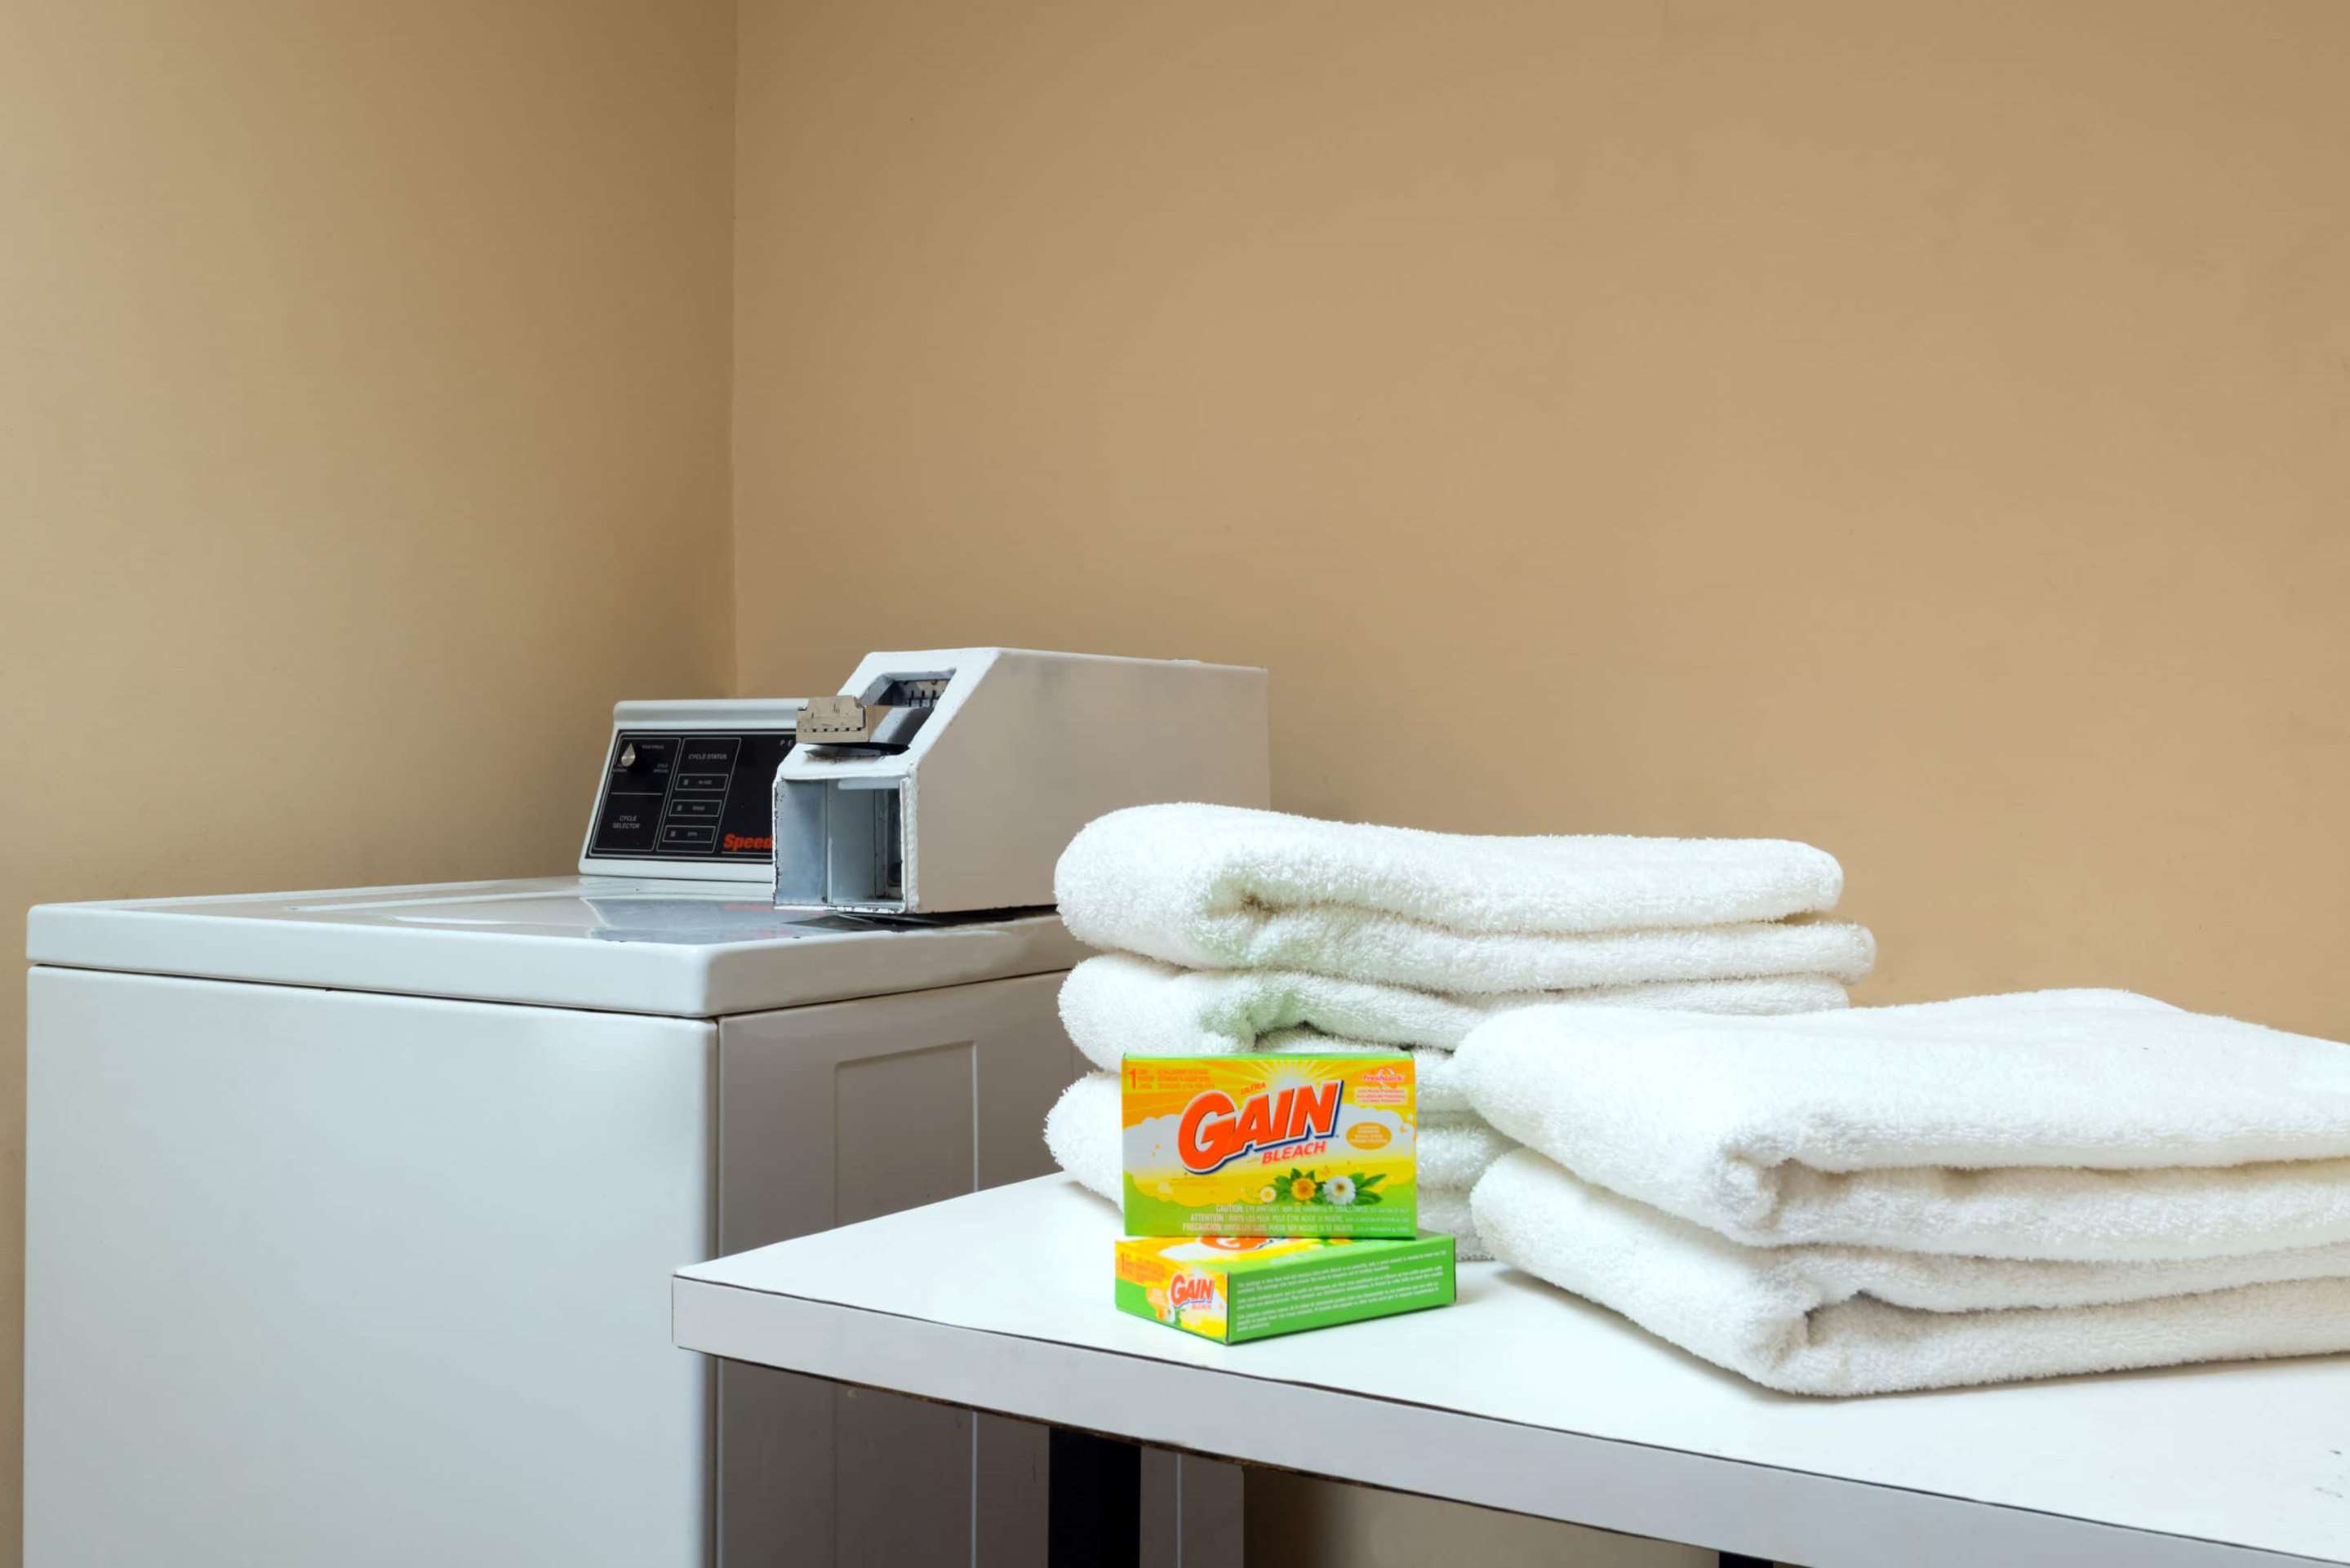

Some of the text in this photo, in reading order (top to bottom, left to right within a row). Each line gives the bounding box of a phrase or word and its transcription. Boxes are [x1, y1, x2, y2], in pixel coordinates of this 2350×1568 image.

[723, 833, 774, 851] Speed
[1240, 1082, 1267, 1095] ULTRA
[1177, 1081, 1343, 1173] GAIN
[1261, 1140, 1326, 1165] BLEACH
[1171, 1274, 1215, 1306] GAIN
